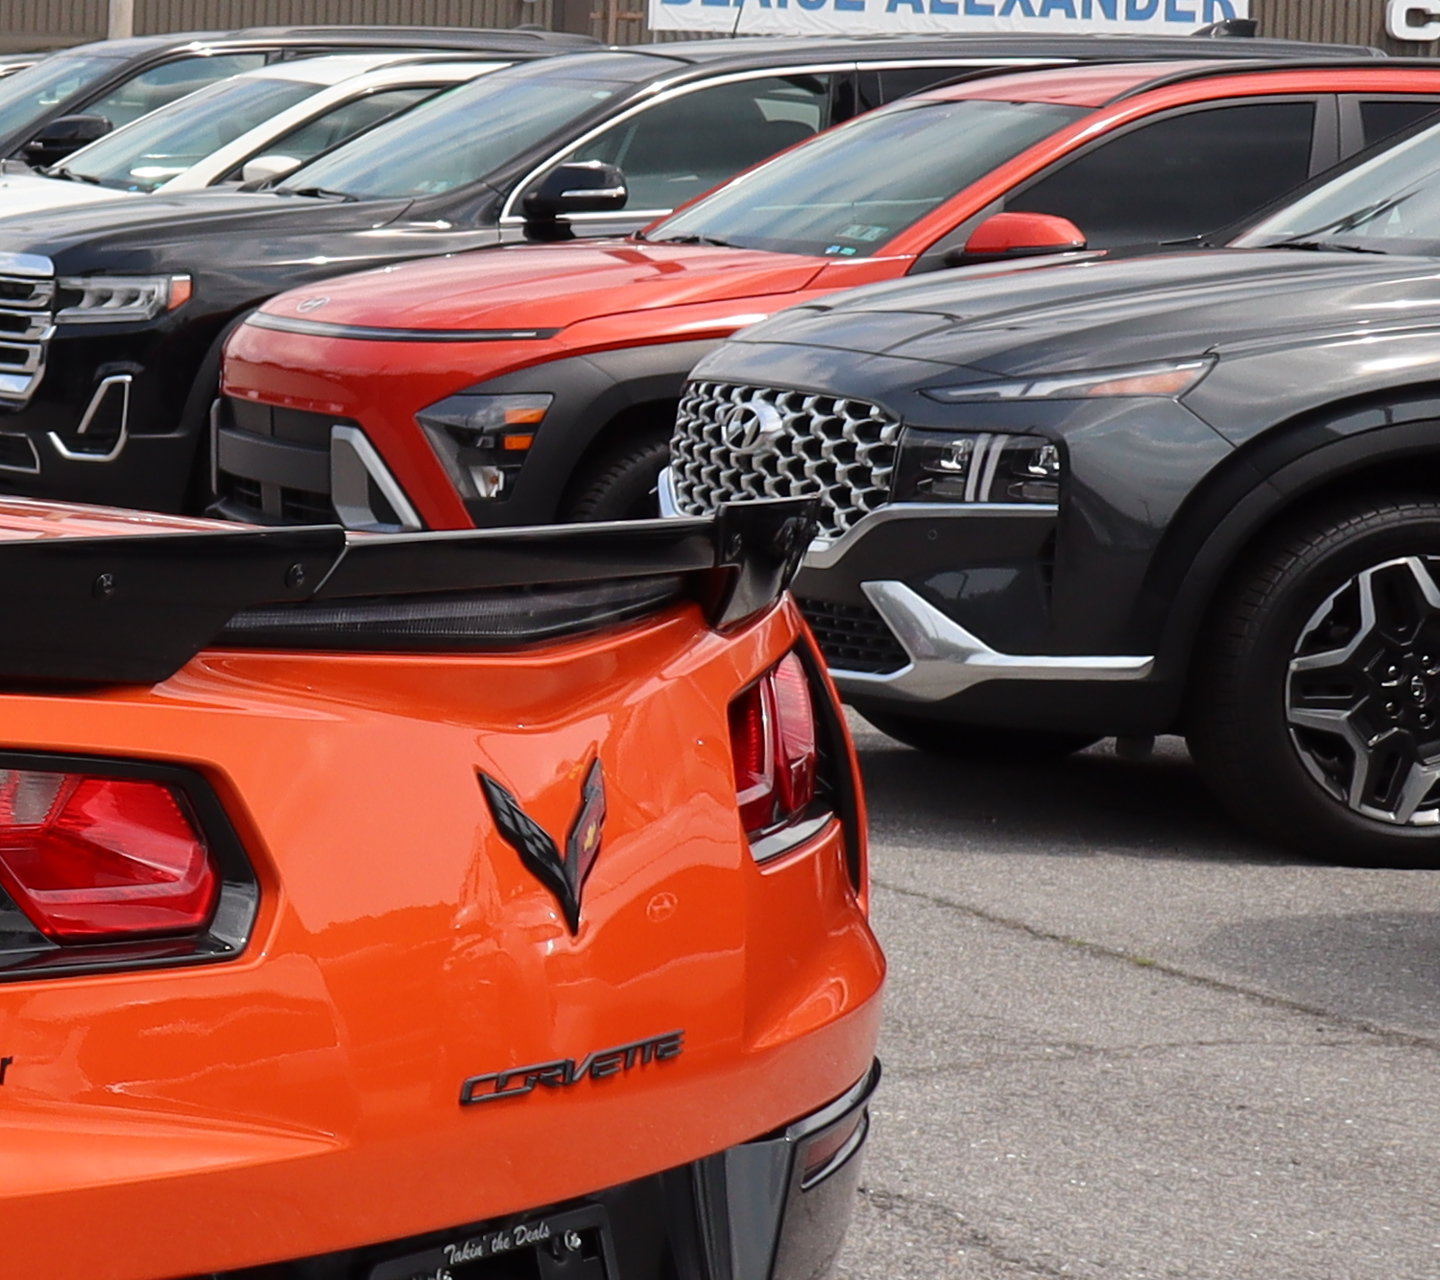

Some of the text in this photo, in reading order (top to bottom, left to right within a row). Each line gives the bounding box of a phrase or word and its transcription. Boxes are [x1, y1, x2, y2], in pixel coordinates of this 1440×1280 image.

[459, 1029, 685, 1105] CORVETTE
[444, 1222, 550, 1264] Takin' the Deals
